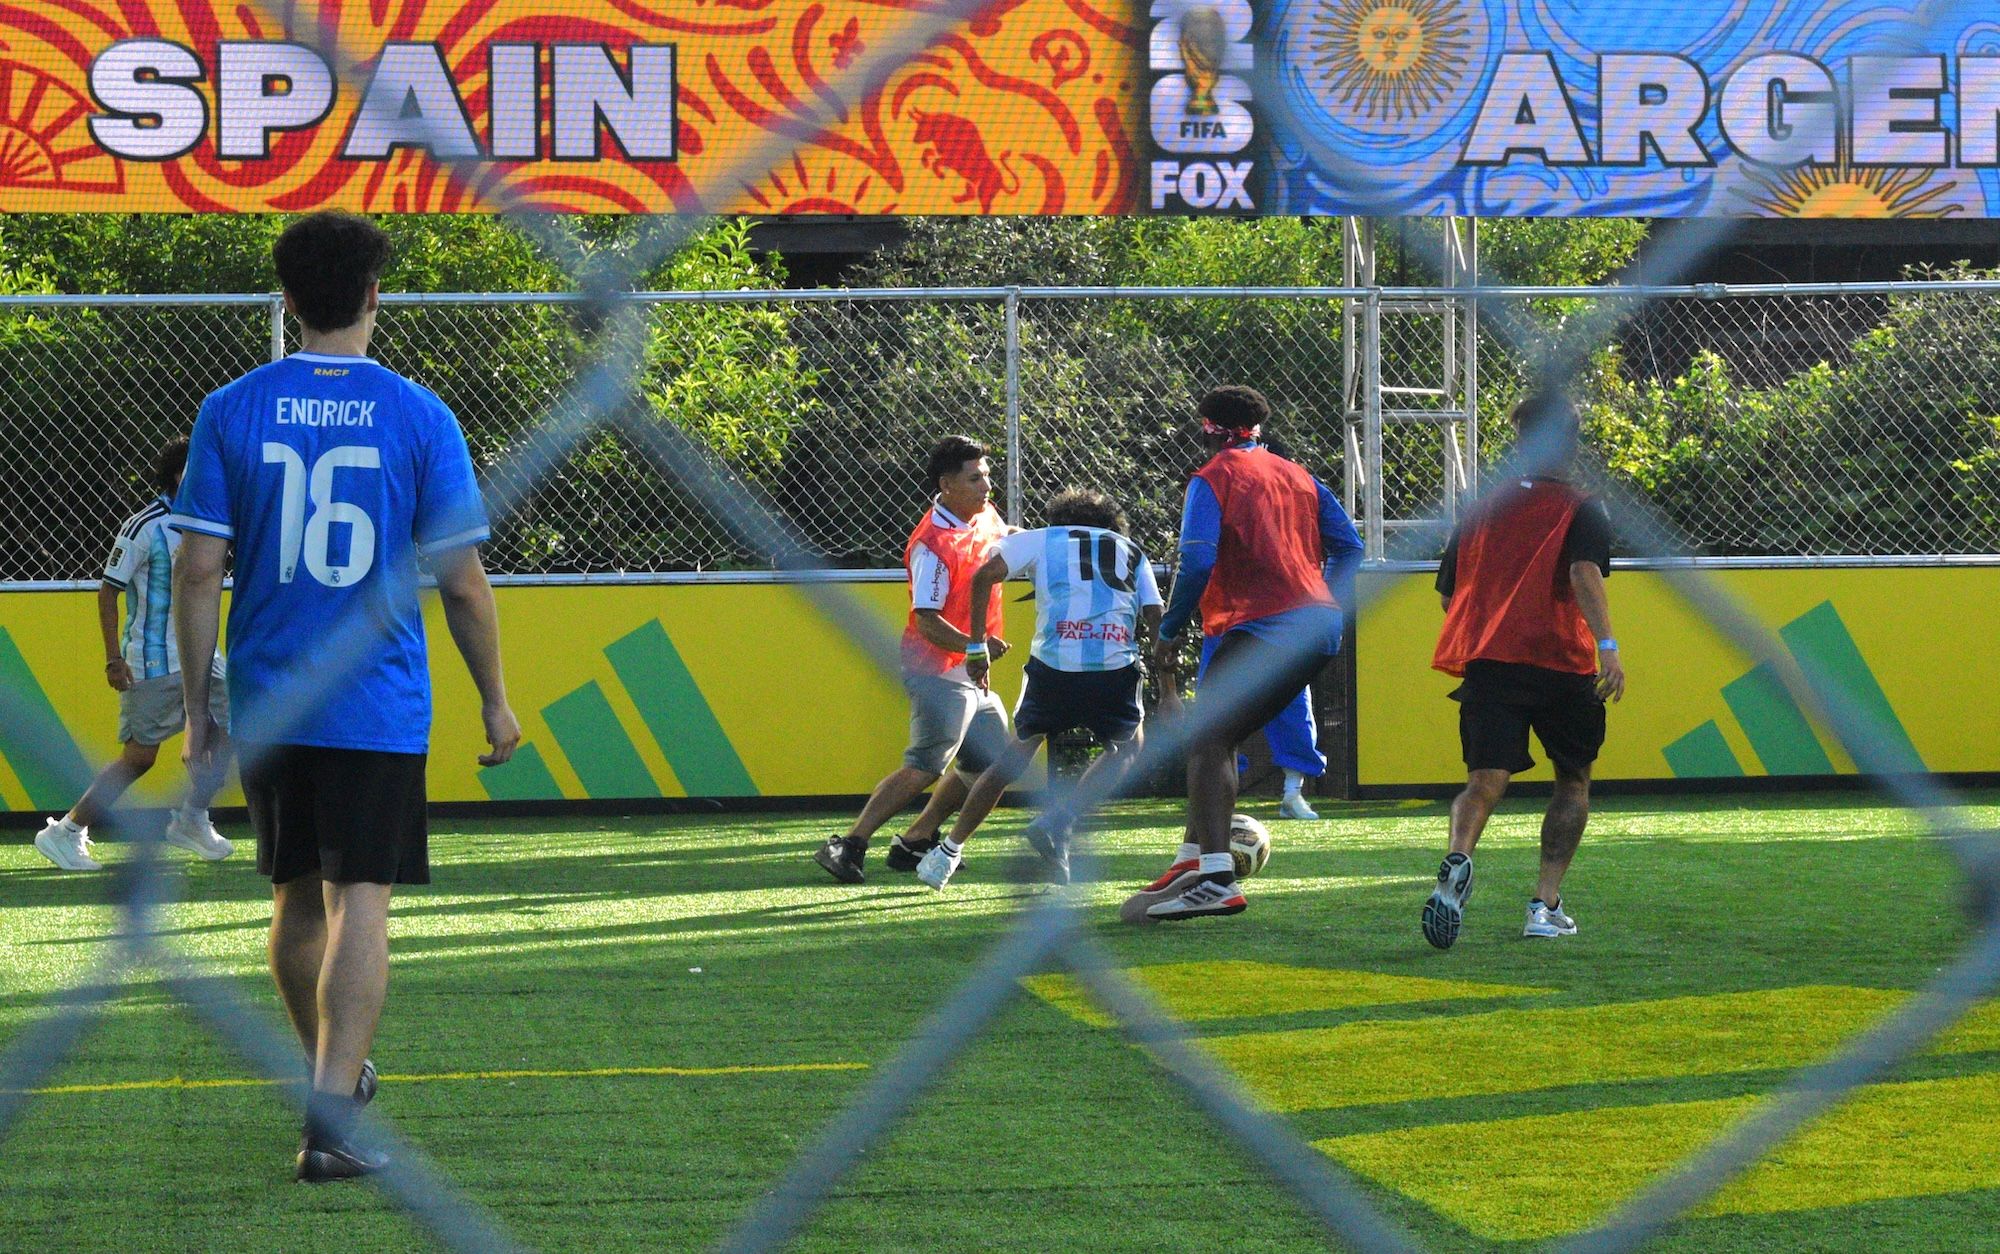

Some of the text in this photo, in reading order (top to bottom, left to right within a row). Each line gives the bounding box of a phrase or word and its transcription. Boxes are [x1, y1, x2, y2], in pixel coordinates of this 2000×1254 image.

[88, 38, 677, 161] SPAIN
[1180, 121, 1227, 139] FIFA
[1151, 161, 1256, 209] FOX
[313, 367, 350, 377] RMCF
[276, 397, 376, 427] ENDRICK
[262, 441, 381, 587] 16
[1068, 529, 1142, 593] 10
[1056, 620, 1093, 632] END
